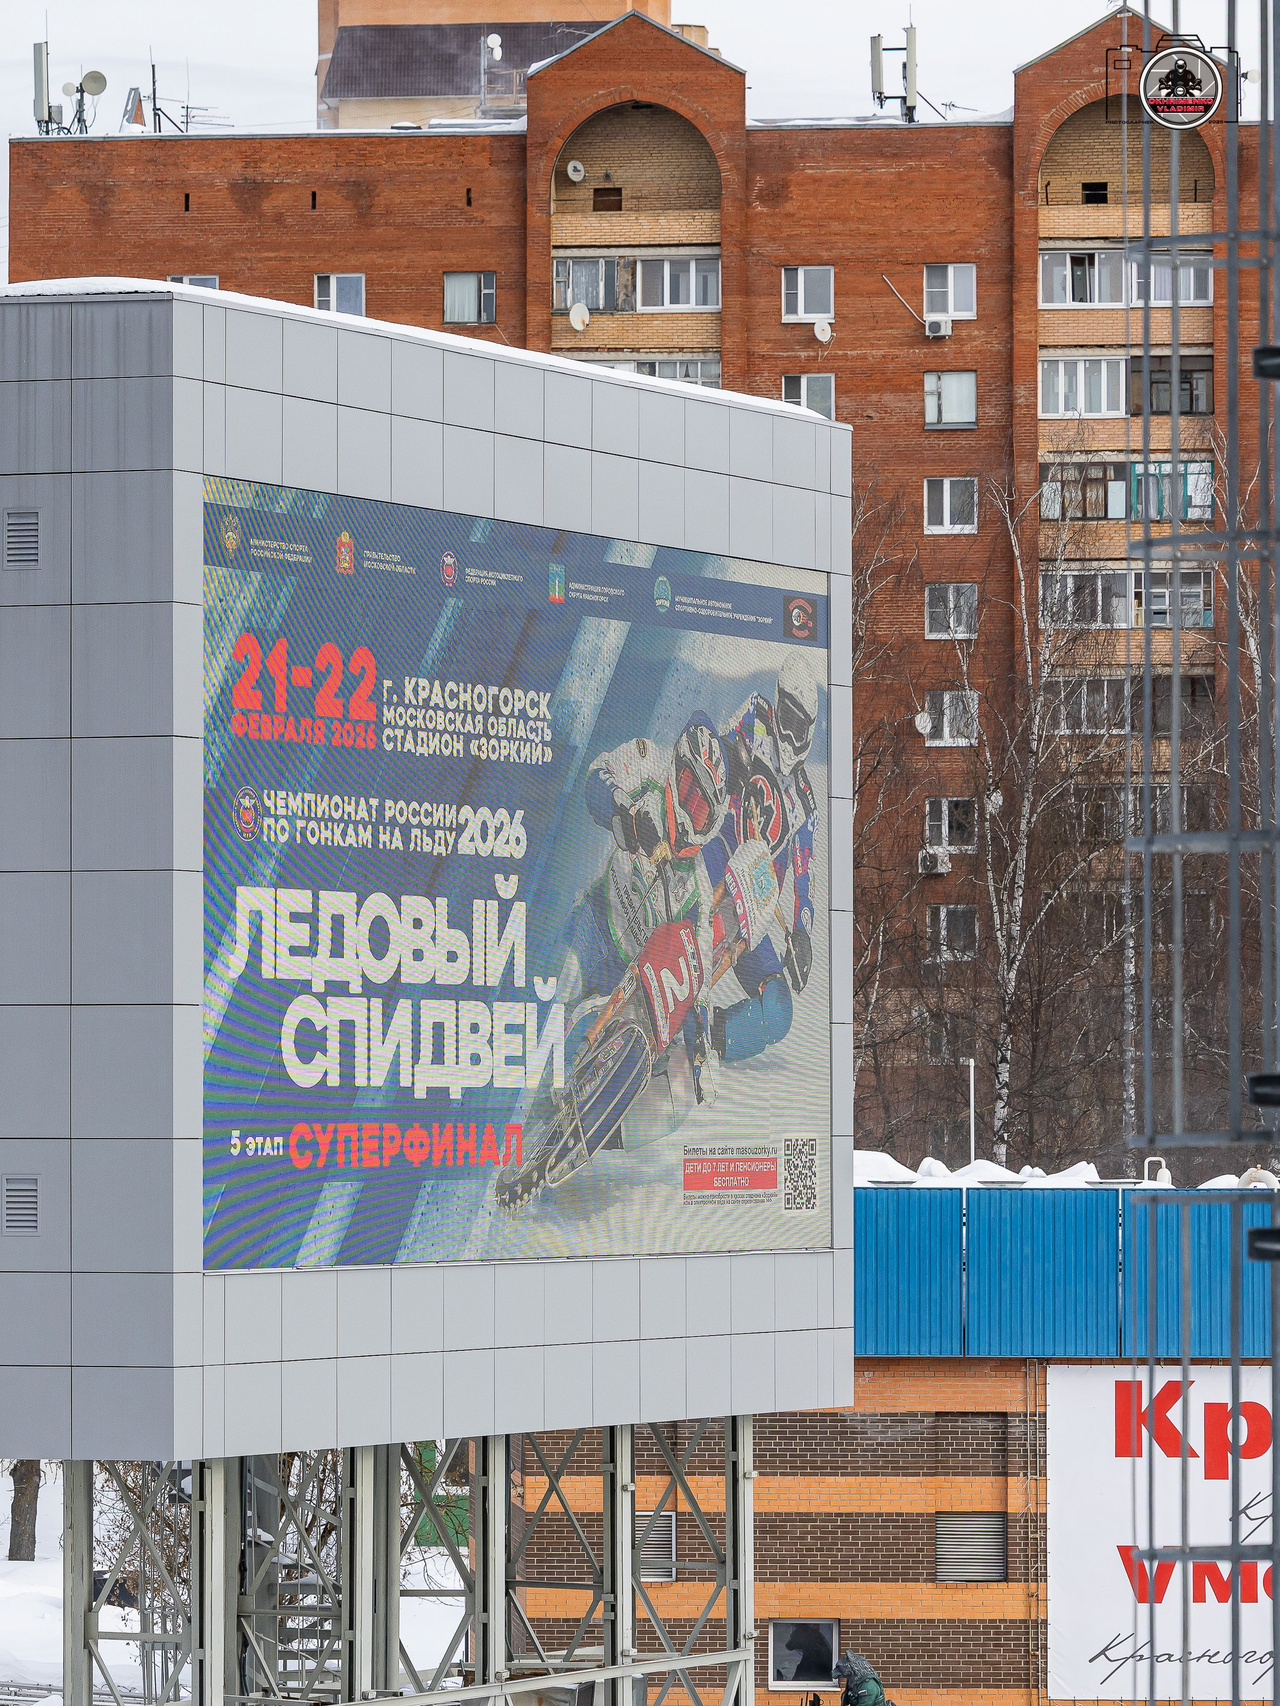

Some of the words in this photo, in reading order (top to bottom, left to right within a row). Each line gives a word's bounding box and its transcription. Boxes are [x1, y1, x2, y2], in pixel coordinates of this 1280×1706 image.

[232, 633, 377, 721] 21-22
[404, 676, 552, 720] КРАСНОГОРСК
[231, 711, 325, 745] ФЕВРАЛЯ
[331, 720, 377, 750] 2026
[382, 704, 484, 735] МОСКОВСКАЯ
[487, 715, 552, 742] ОБЛАСТЬ
[382, 727, 464, 758] СТАДИОН
[470, 736, 553, 765] «ЗОРКИЙ»
[263, 790, 379, 823] ЧЕМПИОНАТ
[384, 799, 457, 829] РОССИИ
[263, 818, 289, 844] ПО
[295, 819, 372, 849] ГОНКАМ
[379, 826, 404, 851] НА
[409, 828, 457, 857] ЛЬДУ
[457, 804, 528, 860] 2026
[226, 873, 527, 994] ЛЕДОВЫЙ
[280, 976, 566, 1100] СПИДВЕЙ
[230, 1129, 241, 1157] 5
[245, 1136, 284, 1157] ЭТАП
[288, 1122, 523, 1169] СУПЕРФИНАЛ
[683, 1145, 708, 1156] Билеты
[709, 1147, 717, 1155] на
[718, 1145, 735, 1155] сайте
[685, 1162, 702, 1174] ДЕТИ
[702, 1162, 712, 1174] ДО
[717, 1161, 729, 1173] ЛЕТ
[729, 1161, 735, 1172] И
[735, 1161, 777, 1173] ПЕНСИОНЕРЫ
[713, 1176, 750, 1187] БЕСПЛАТНО
